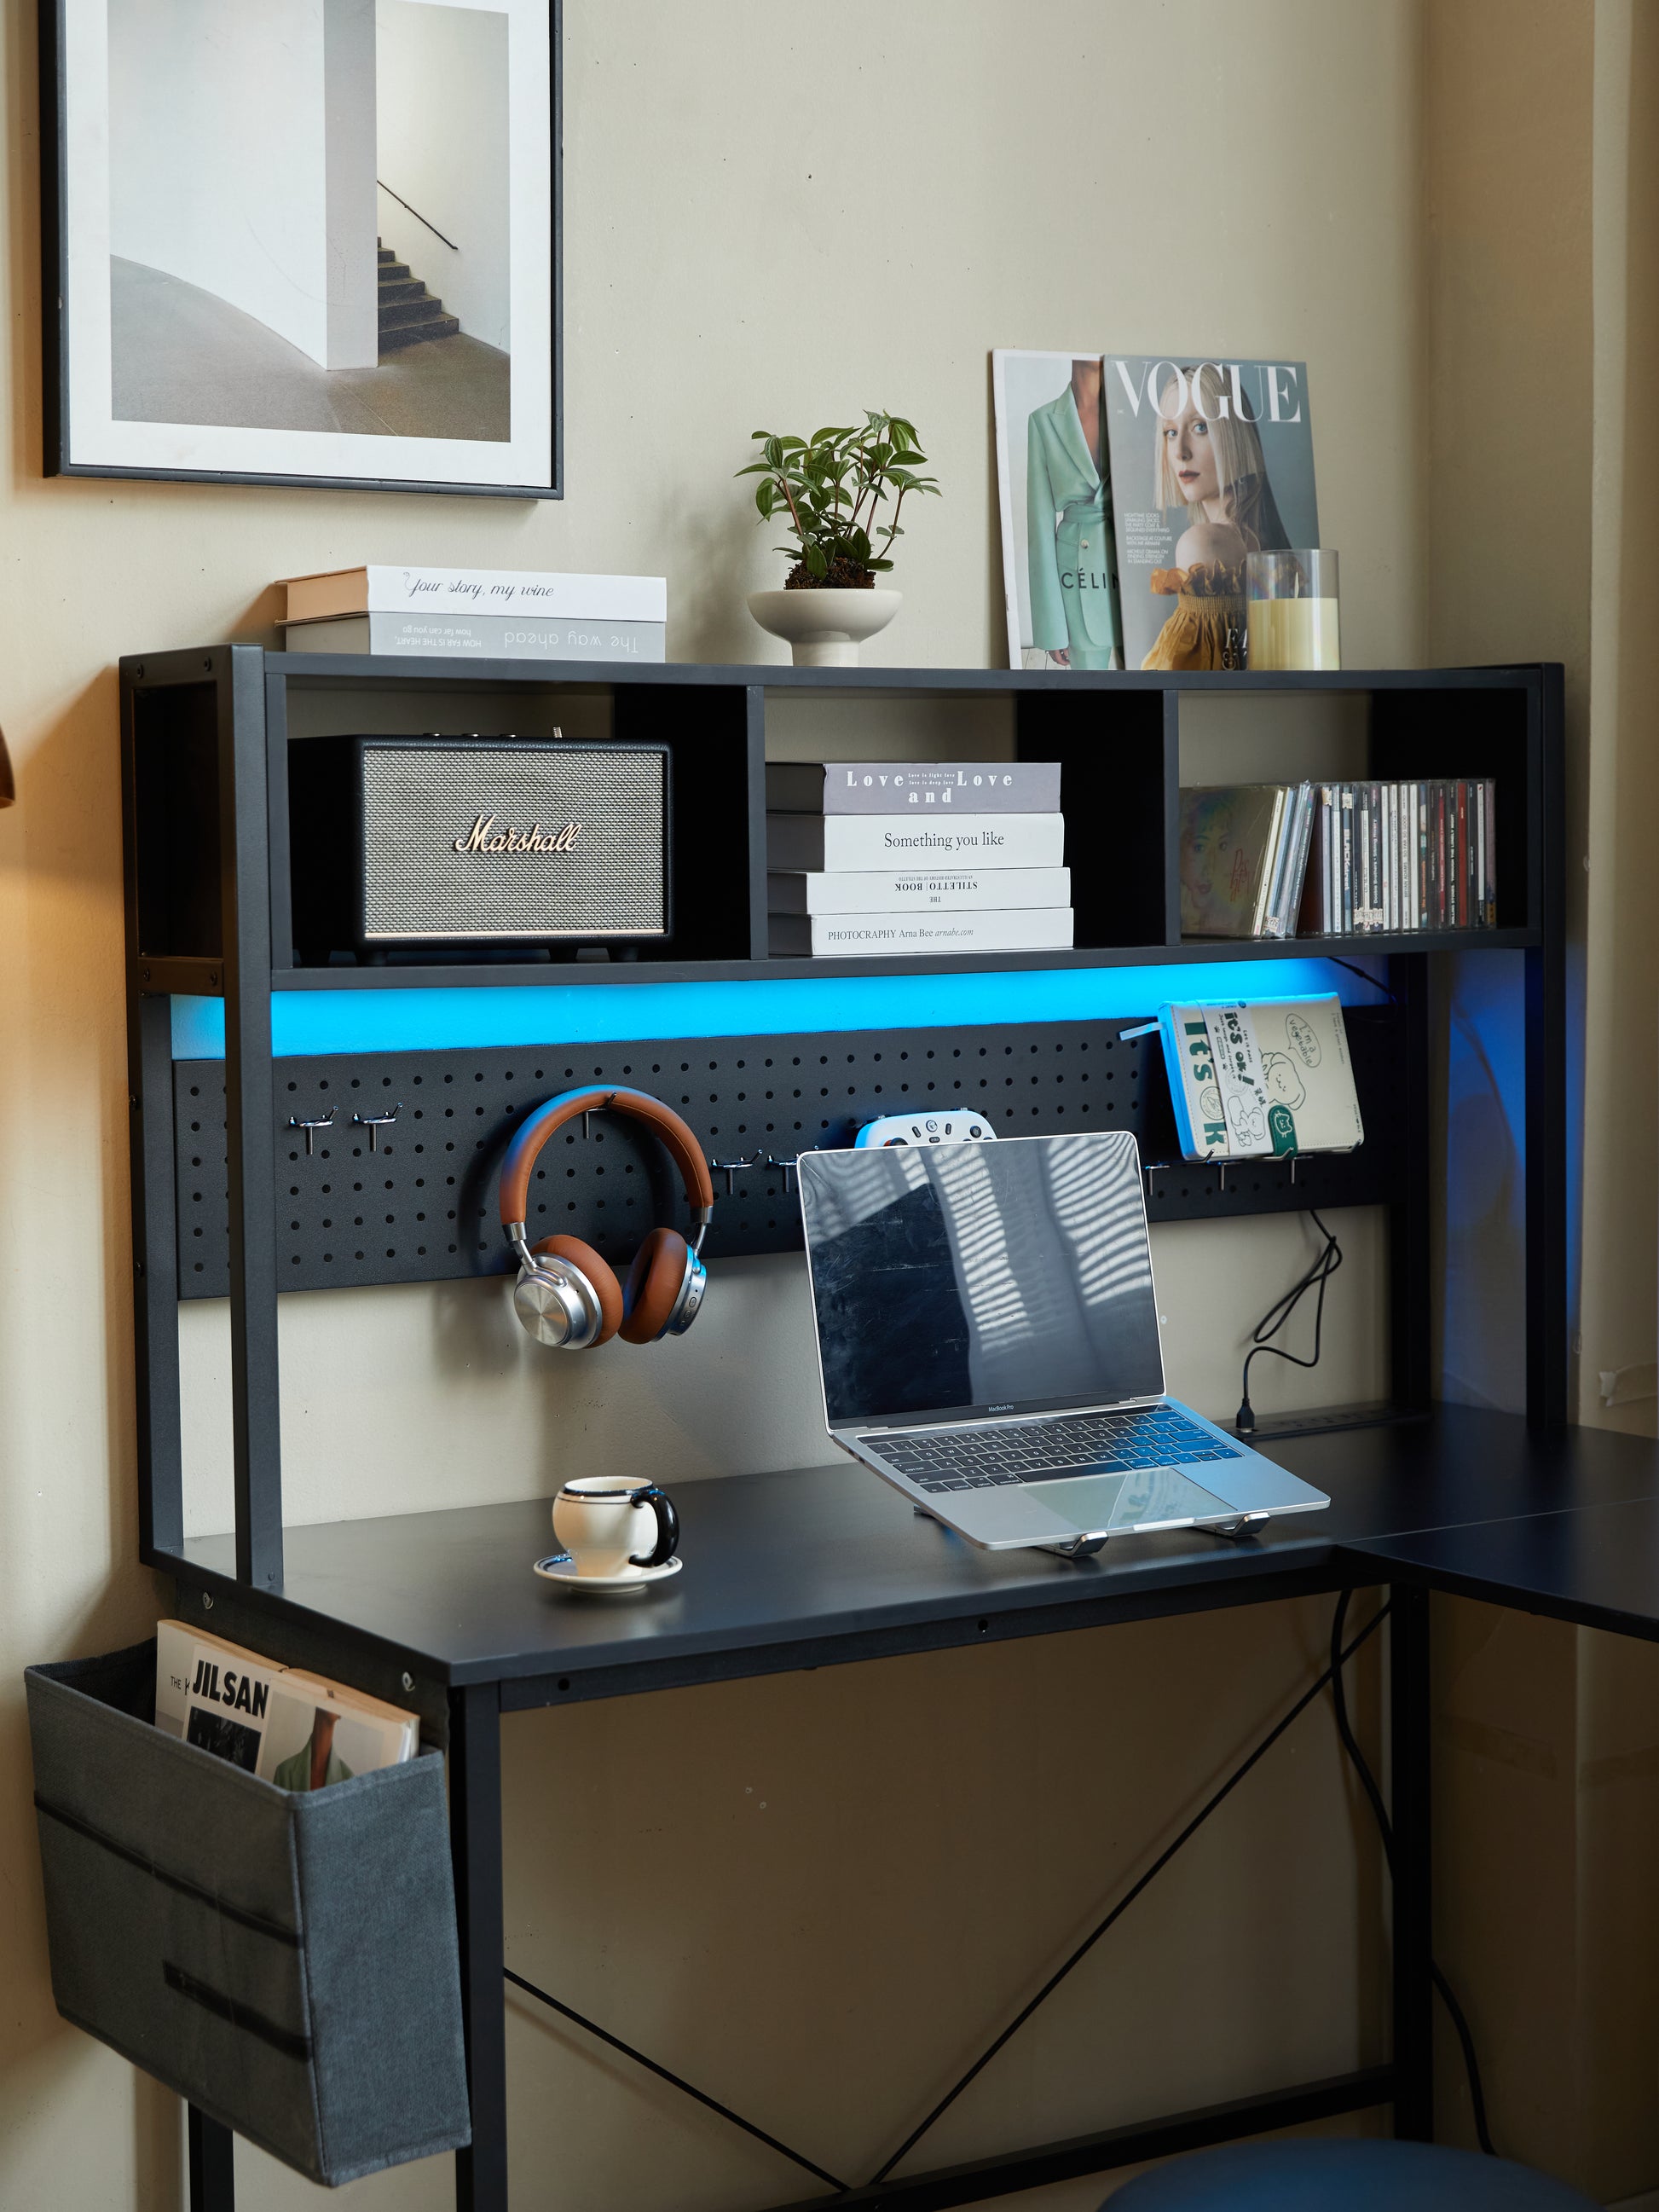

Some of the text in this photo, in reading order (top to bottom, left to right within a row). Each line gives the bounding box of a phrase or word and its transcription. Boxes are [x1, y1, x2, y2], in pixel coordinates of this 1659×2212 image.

[1111, 361, 1301, 422] VOGUE
[403, 571, 554, 601] Your story, my wine
[442, 628, 454, 636] far
[455, 628, 471, 637] how
[423, 637, 437, 646] THE
[438, 638, 445, 646] IS
[447, 639, 461, 647] FAR
[462, 639, 482, 648] HOW
[504, 631, 639, 653] The way ahead
[846, 771, 1013, 786] Love Love
[908, 787, 951, 803] and
[454, 814, 581, 852] Marshall
[884, 831, 1004, 851] Something you like
[895, 882, 978, 891] STILETTO BOOK
[934, 927, 974, 936] arnabe.com
[1299, 1025, 1313, 1044] I'm
[1289, 1019, 1313, 1066] vegetable
[171, 1676, 181, 1689] THE
